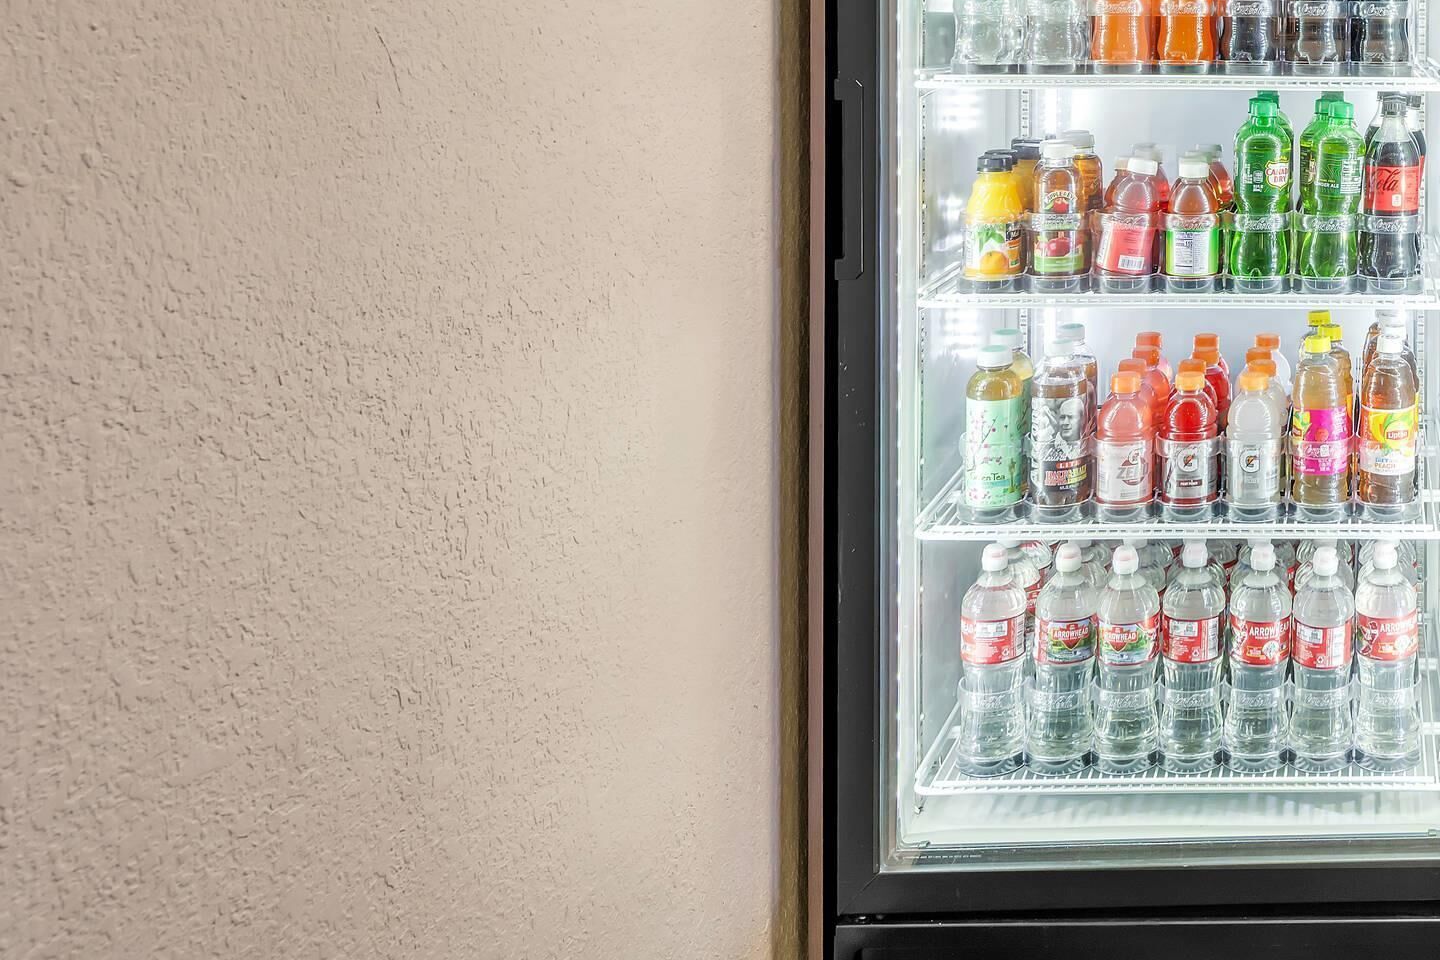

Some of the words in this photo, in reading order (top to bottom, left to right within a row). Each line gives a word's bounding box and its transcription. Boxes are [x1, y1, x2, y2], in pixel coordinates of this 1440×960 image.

[1266, 168, 1289, 176] CANAD
[1387, 430, 1408, 439] Lipton
[1053, 627, 1089, 639] ARROWHEAD
